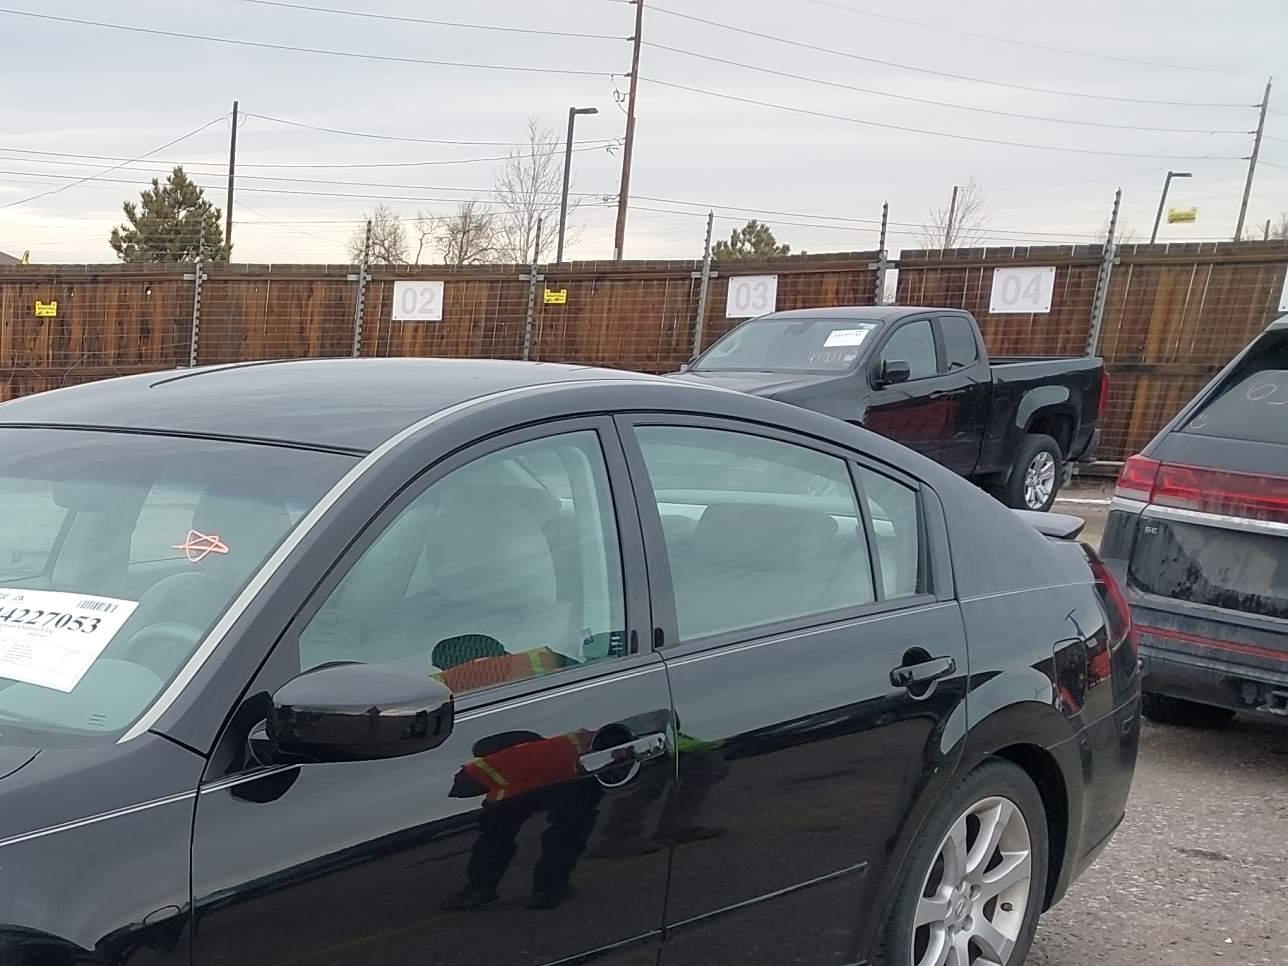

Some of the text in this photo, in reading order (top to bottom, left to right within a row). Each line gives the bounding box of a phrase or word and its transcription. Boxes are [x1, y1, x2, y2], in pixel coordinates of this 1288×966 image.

[401, 287, 435, 314] 02
[735, 281, 769, 311] 03
[1000, 272, 1042, 305] 04
